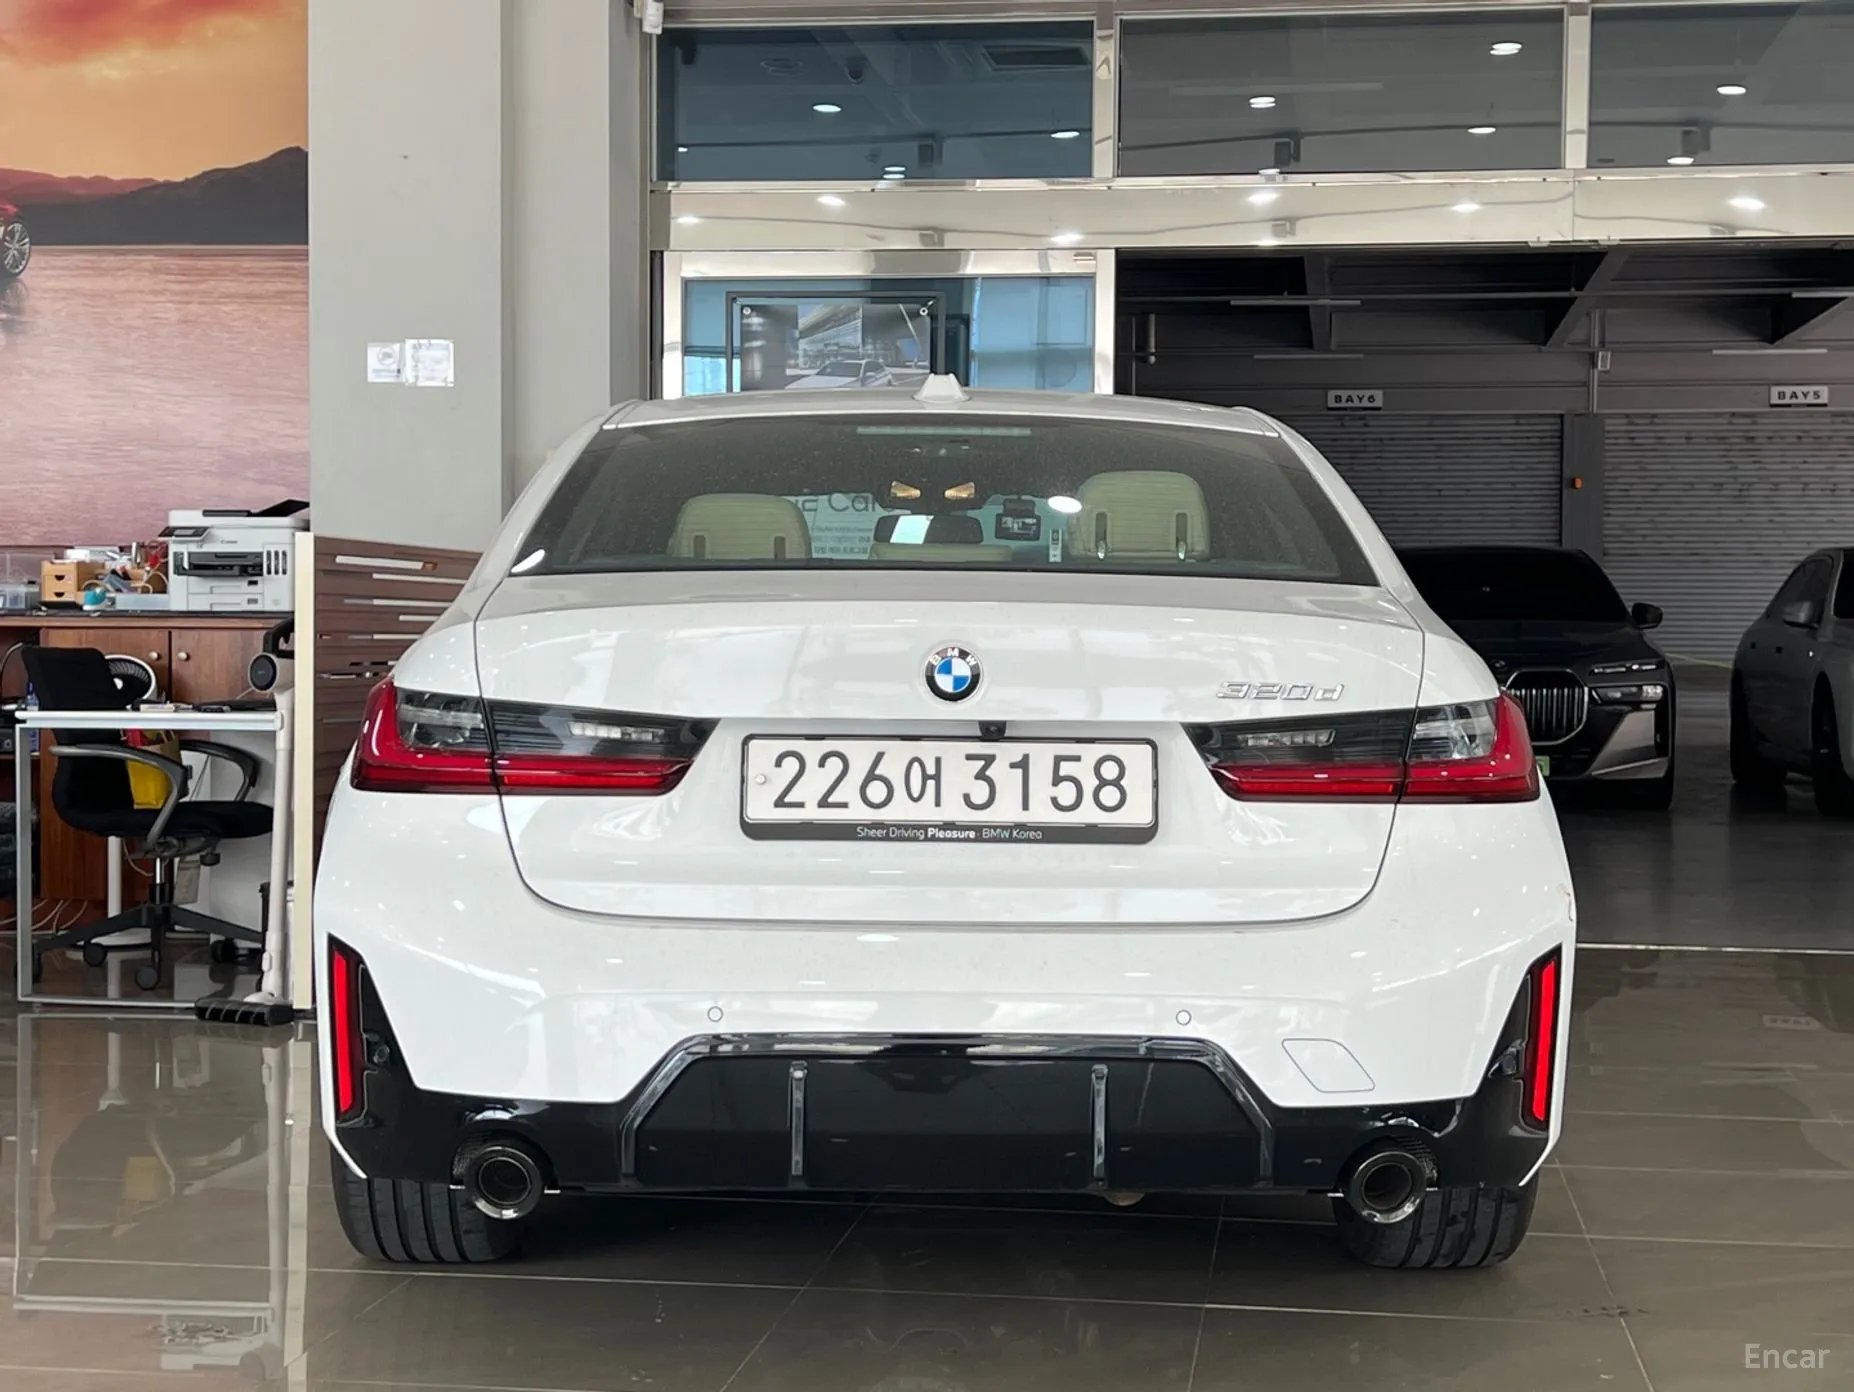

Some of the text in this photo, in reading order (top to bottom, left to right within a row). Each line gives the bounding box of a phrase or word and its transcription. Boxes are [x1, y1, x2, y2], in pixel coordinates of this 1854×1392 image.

[1334, 394, 1376, 404] BAY6
[1777, 390, 1821, 400] BAY5
[1217, 681, 1345, 702] 320d
[773, 750, 1128, 813] 226어 3158
[856, 826, 1042, 841] Sheer Driving Pleasure BMW Korea
